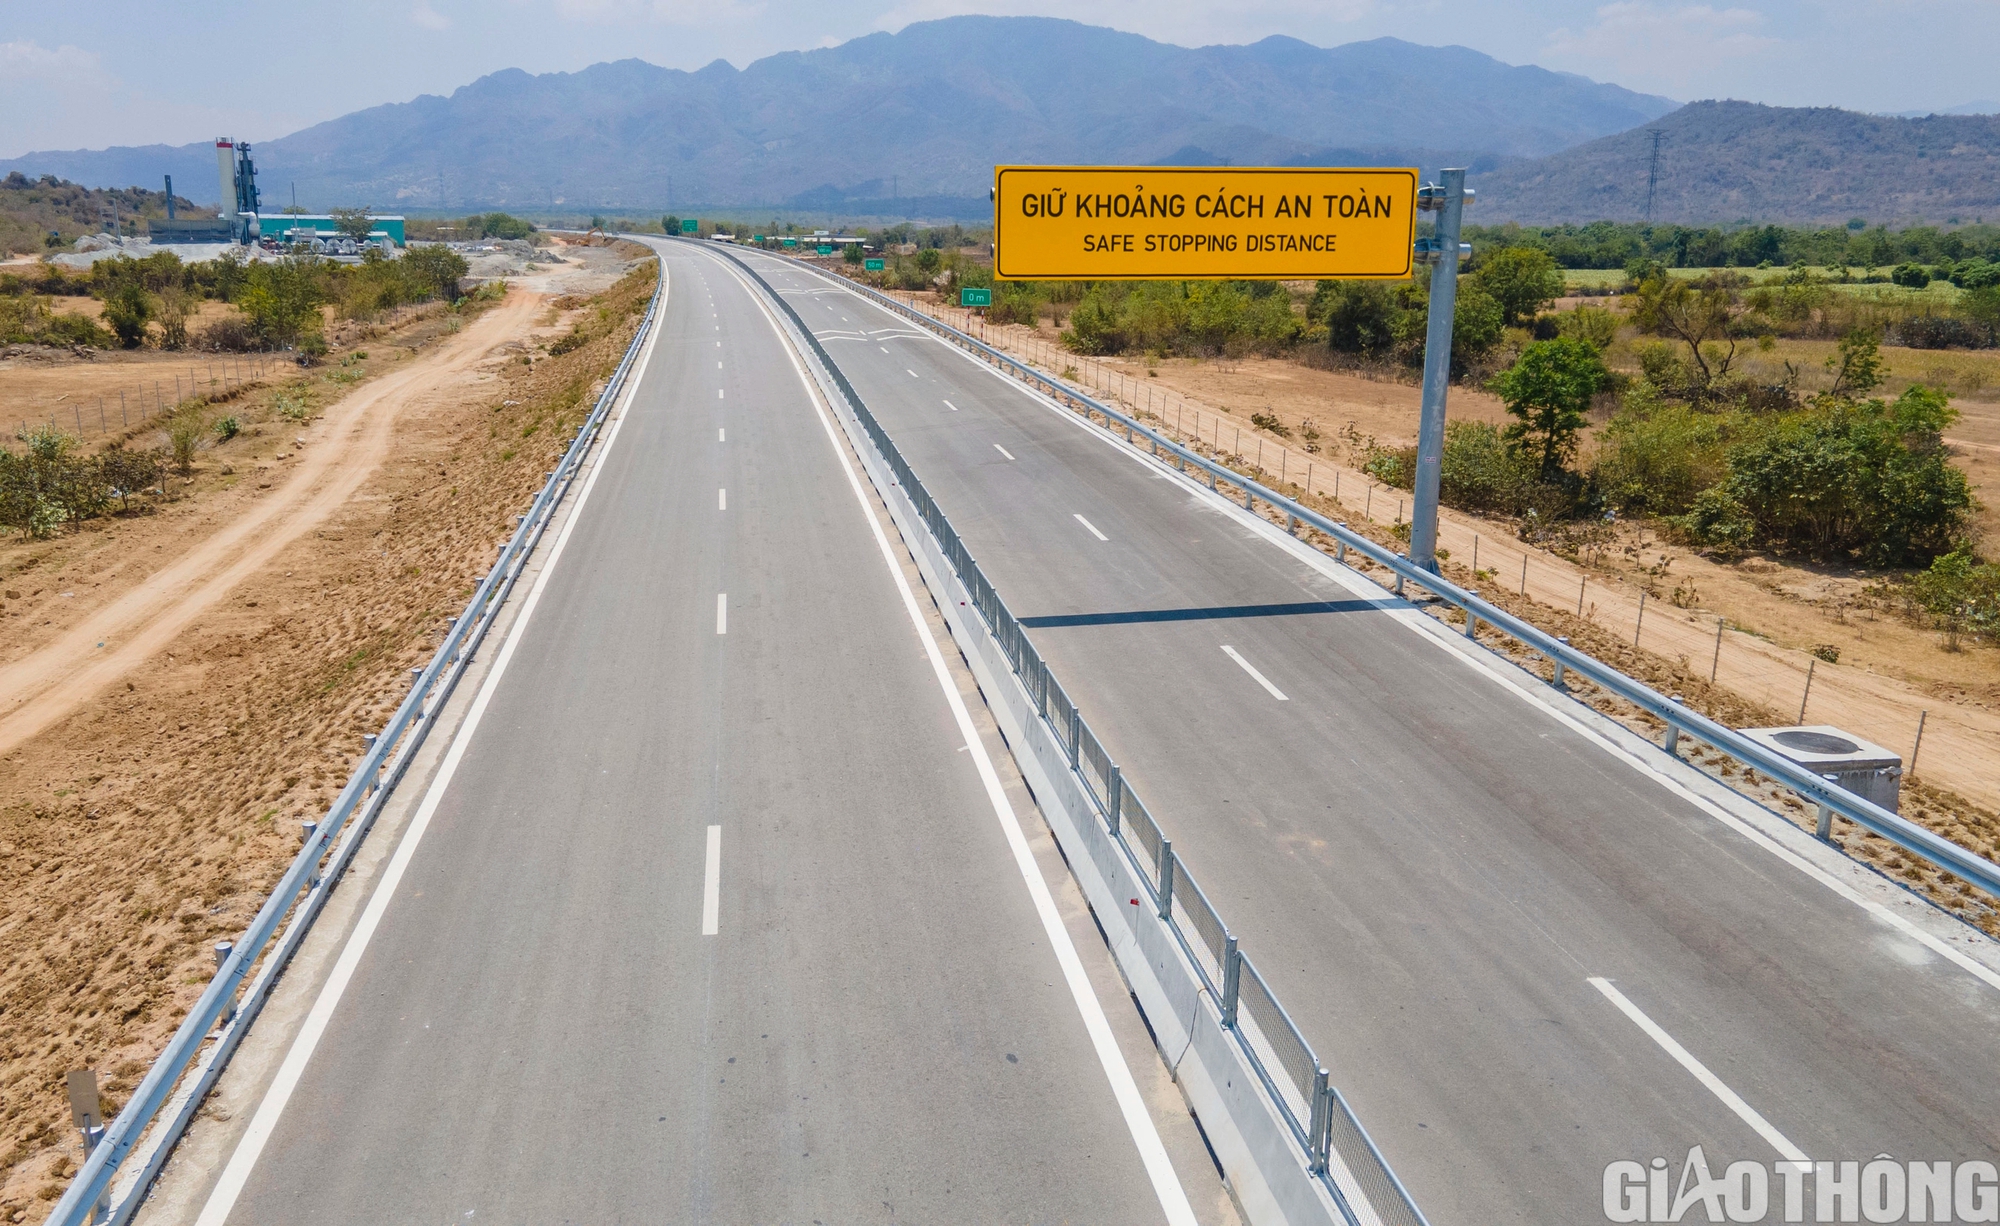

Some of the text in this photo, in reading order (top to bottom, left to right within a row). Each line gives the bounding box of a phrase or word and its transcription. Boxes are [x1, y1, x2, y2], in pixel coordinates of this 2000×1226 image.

[1022, 184, 1392, 218] GIỮ KHOẢNG CÁCH AN TOÀN
[1083, 234, 1337, 252] SAFE STOPPING DISTANCE
[969, 293, 974, 301] 0
